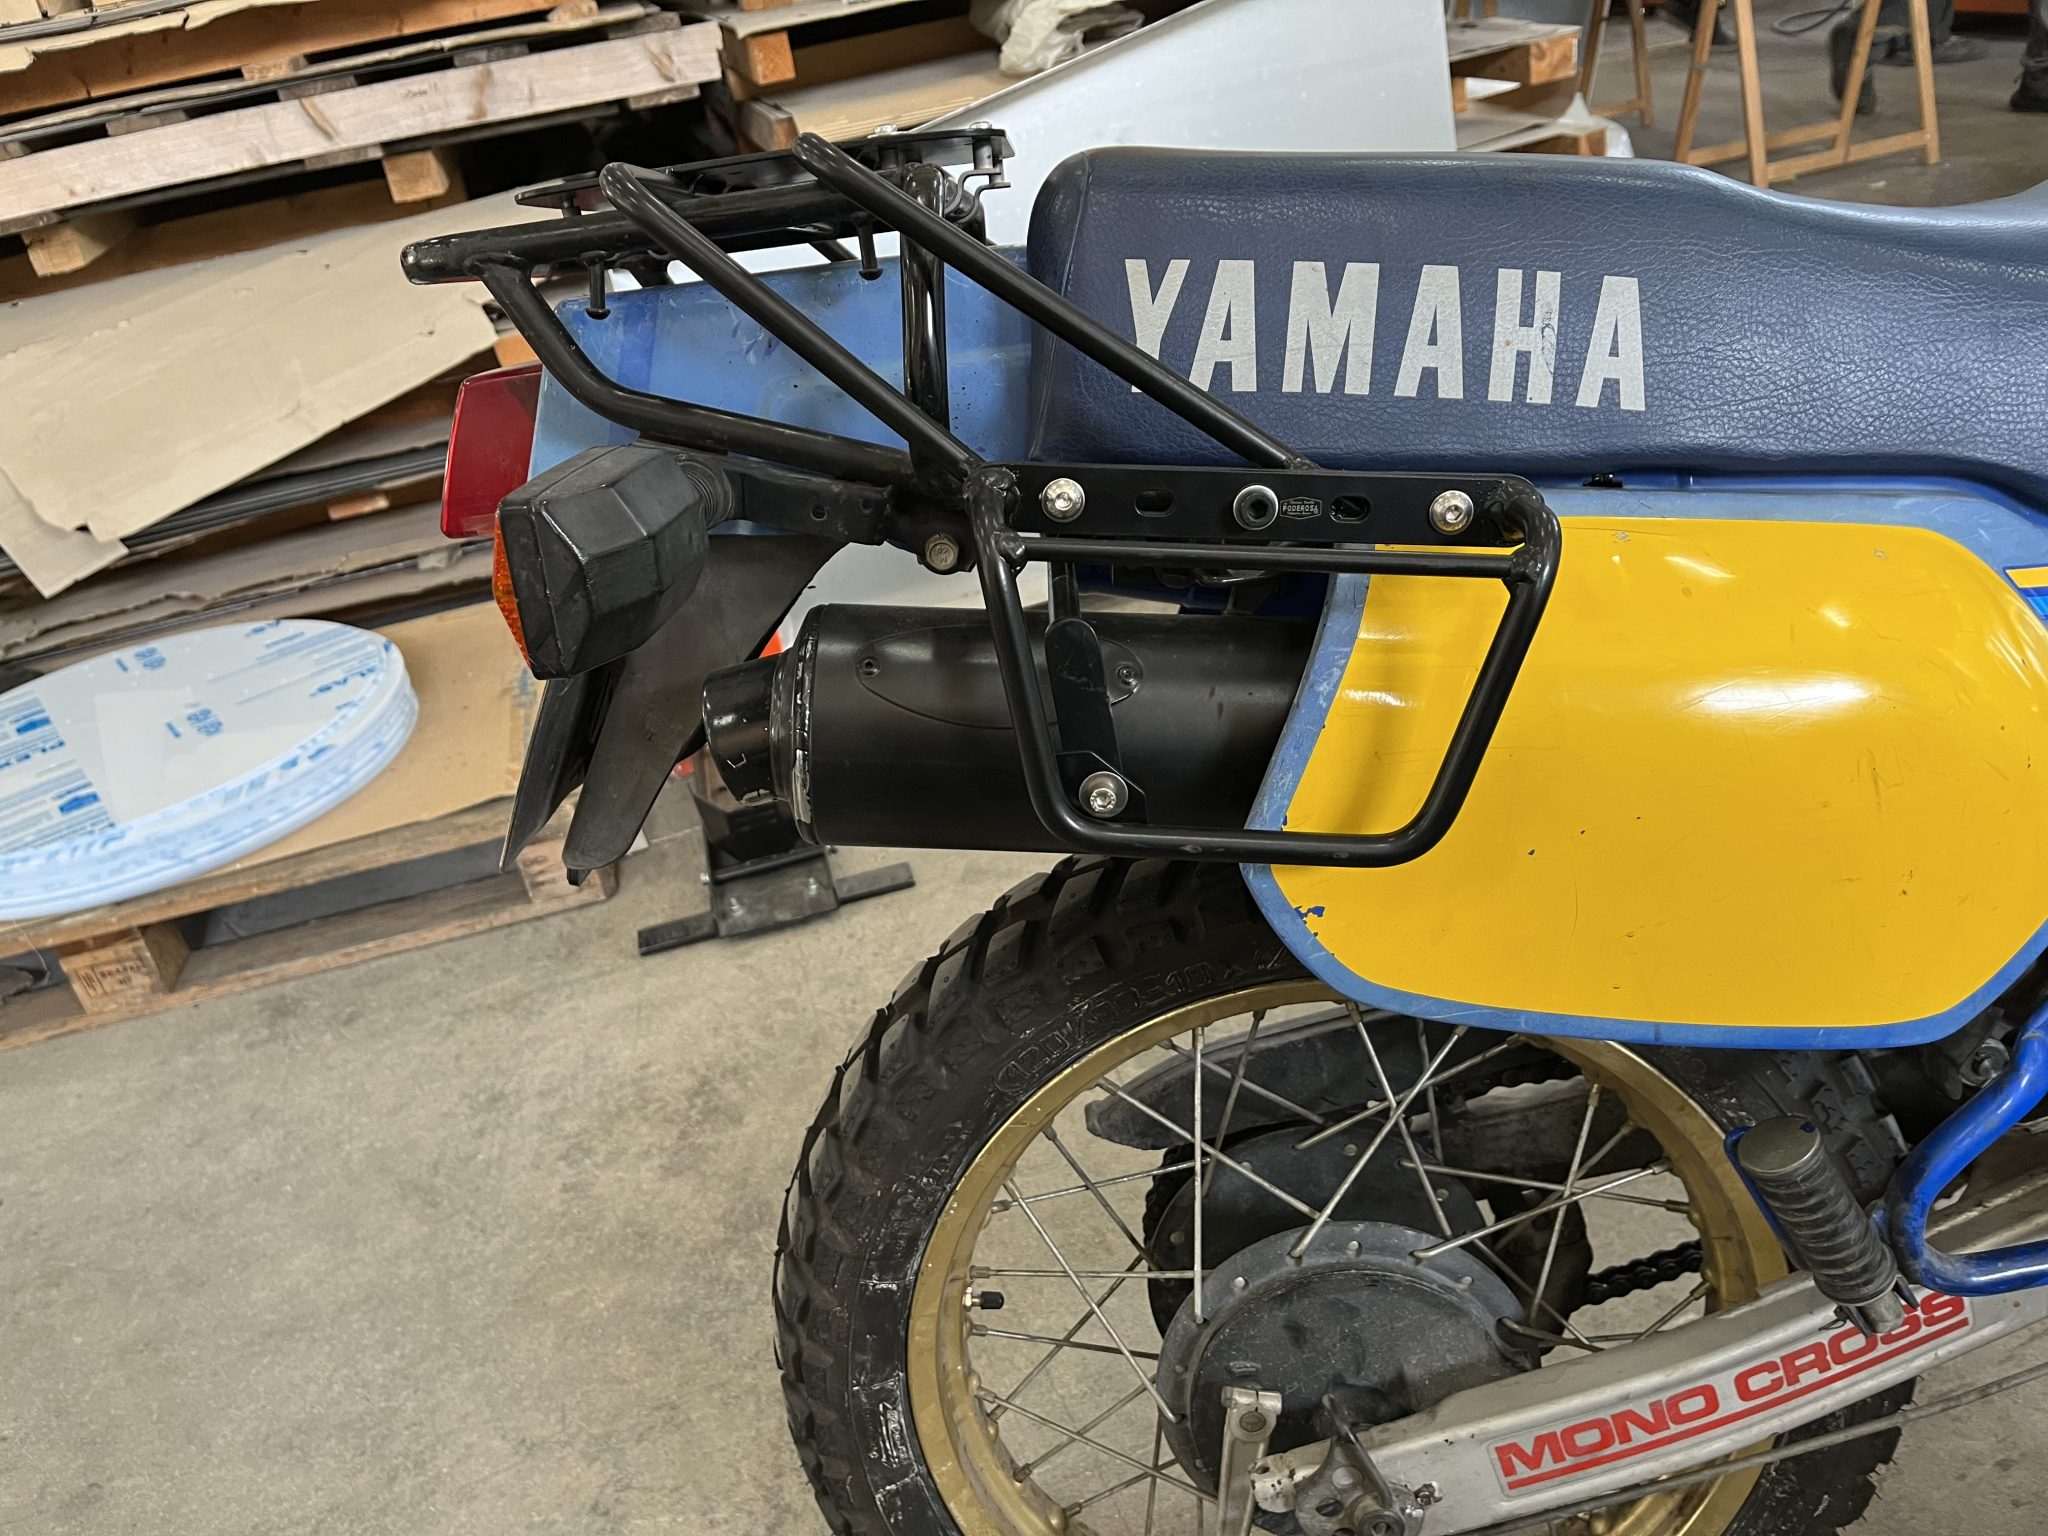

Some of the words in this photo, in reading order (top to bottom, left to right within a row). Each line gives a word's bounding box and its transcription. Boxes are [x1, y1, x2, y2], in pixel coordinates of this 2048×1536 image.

[1124, 258, 1647, 411] YAMAHA
[1282, 503, 1319, 513] PODEROSA
[1494, 1383, 1720, 1478] MONO
